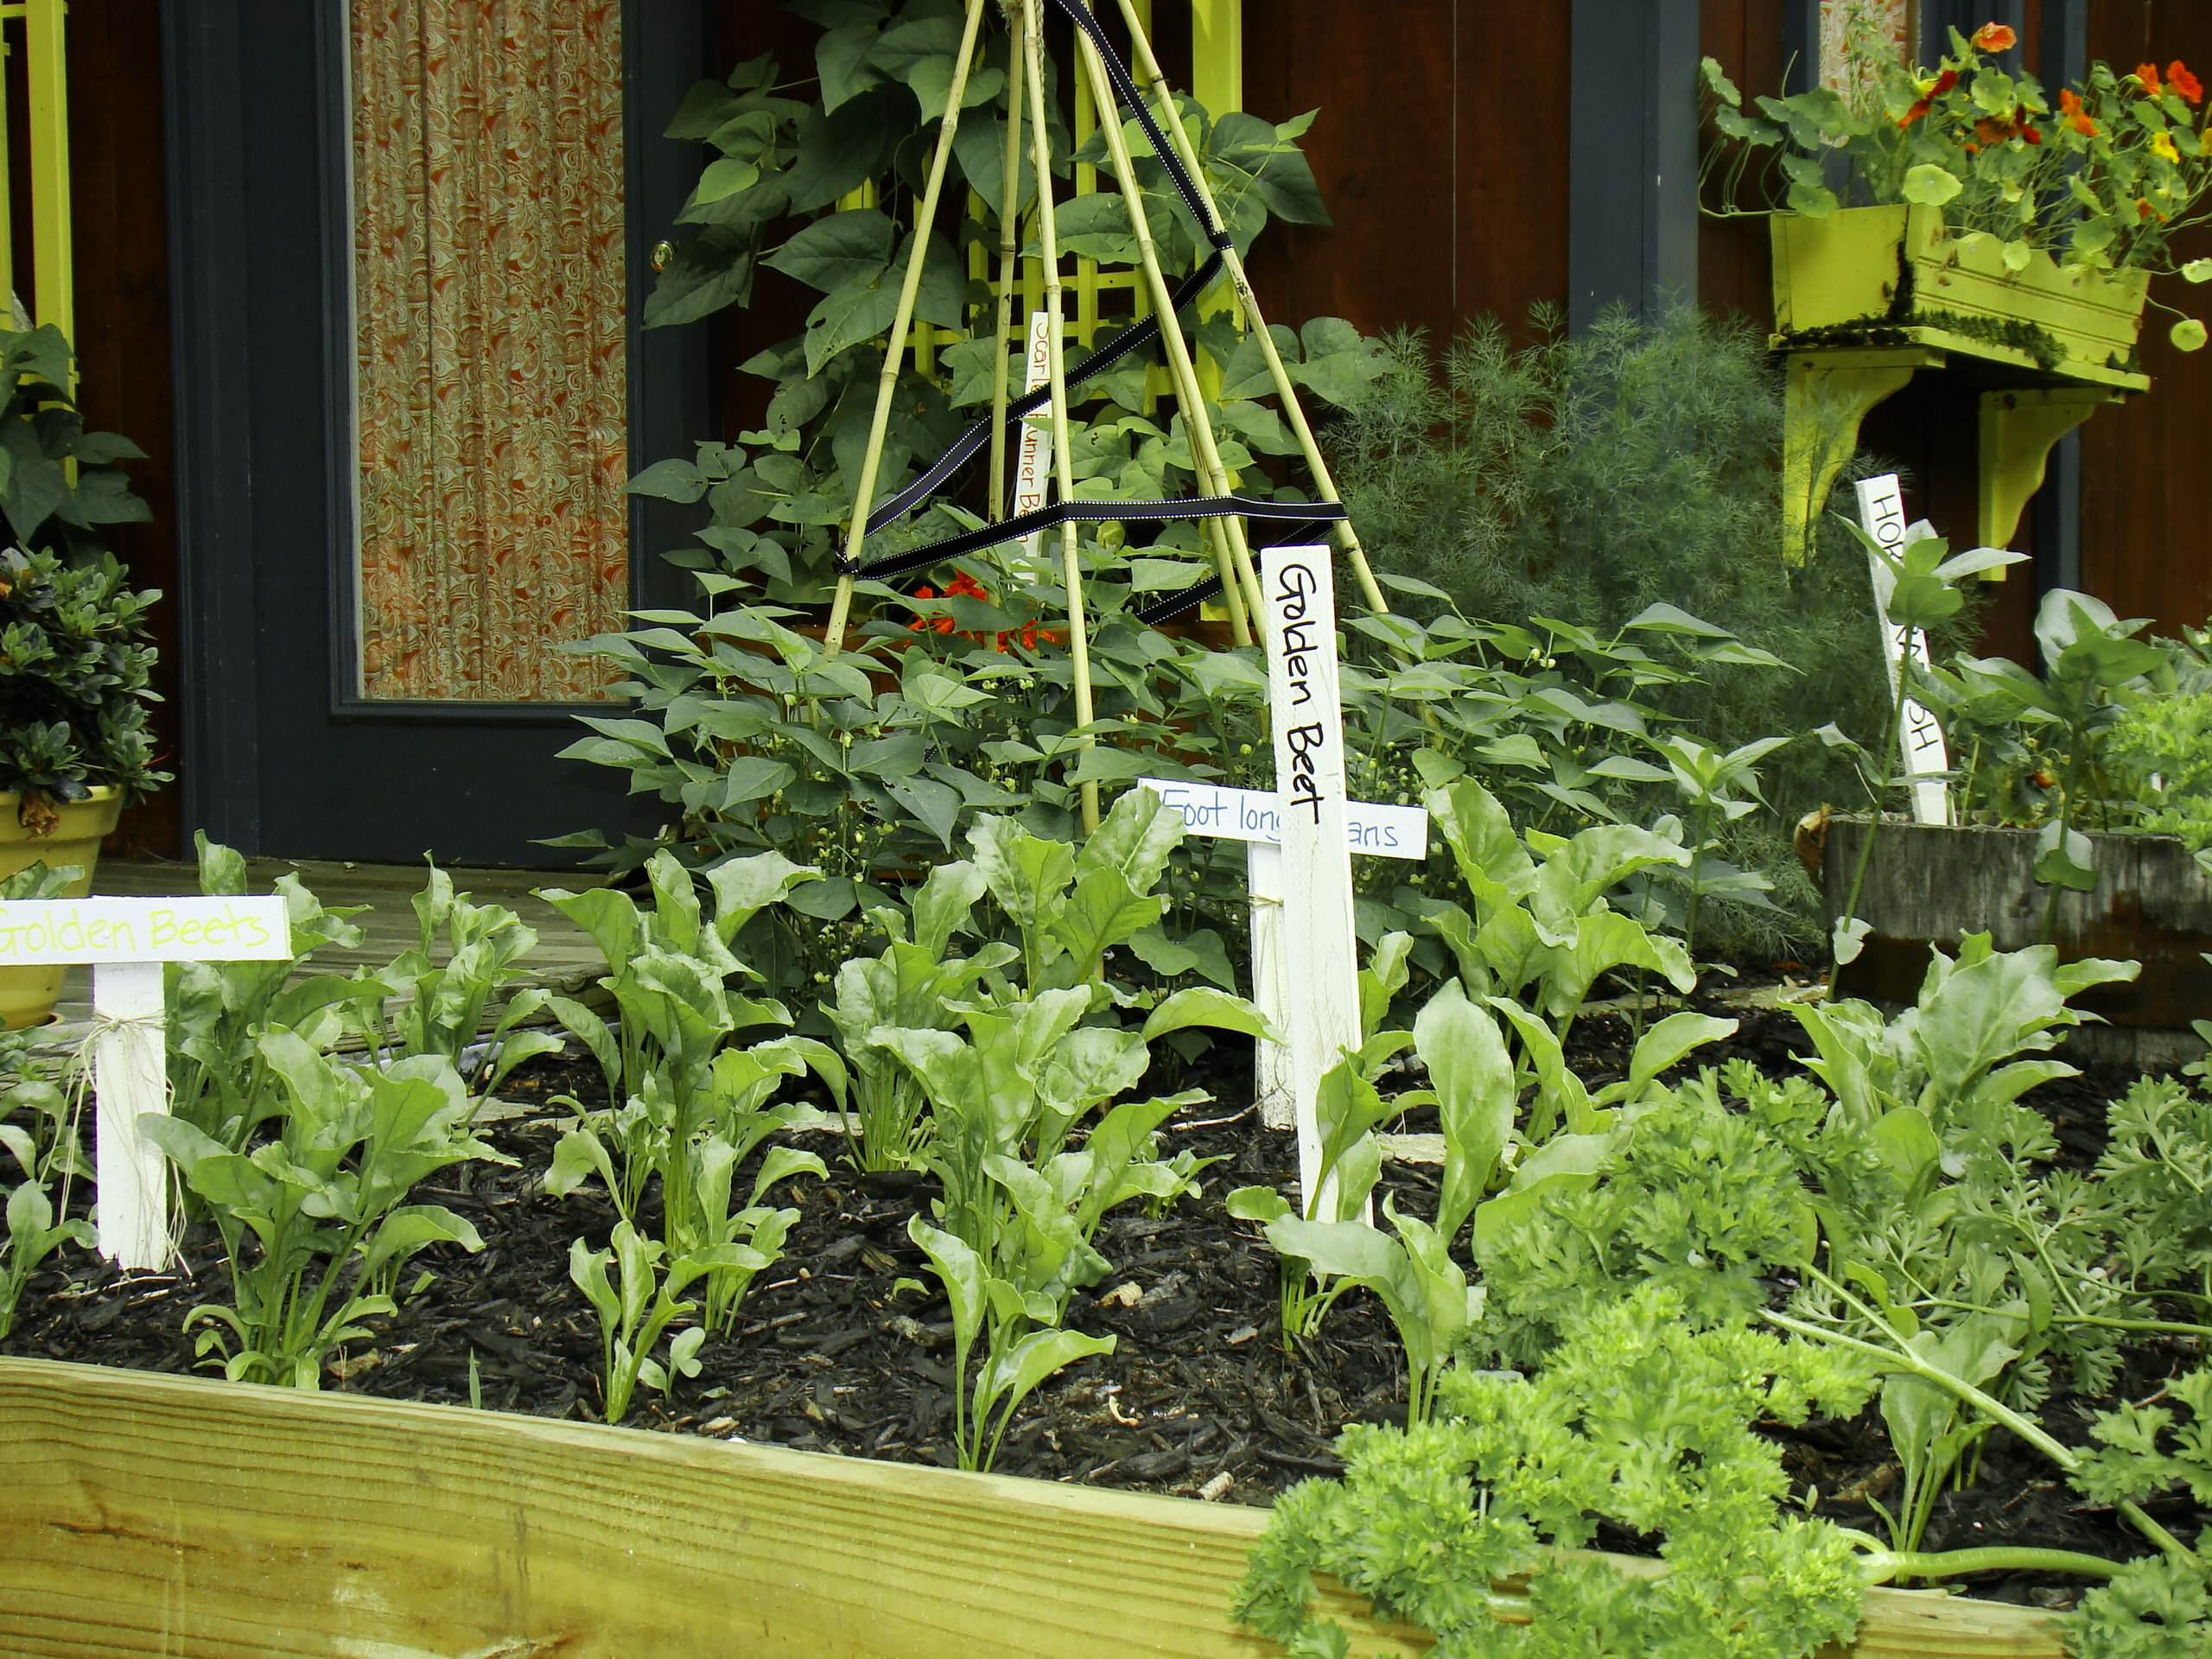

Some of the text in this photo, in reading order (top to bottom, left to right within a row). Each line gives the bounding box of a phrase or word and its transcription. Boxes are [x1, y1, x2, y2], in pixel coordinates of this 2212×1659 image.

[1030, 321, 1051, 393] Scarle
[1275, 563, 1325, 825] Golden Beet
[1239, 794, 1281, 842] lon
[149, 903, 270, 949] Beets
